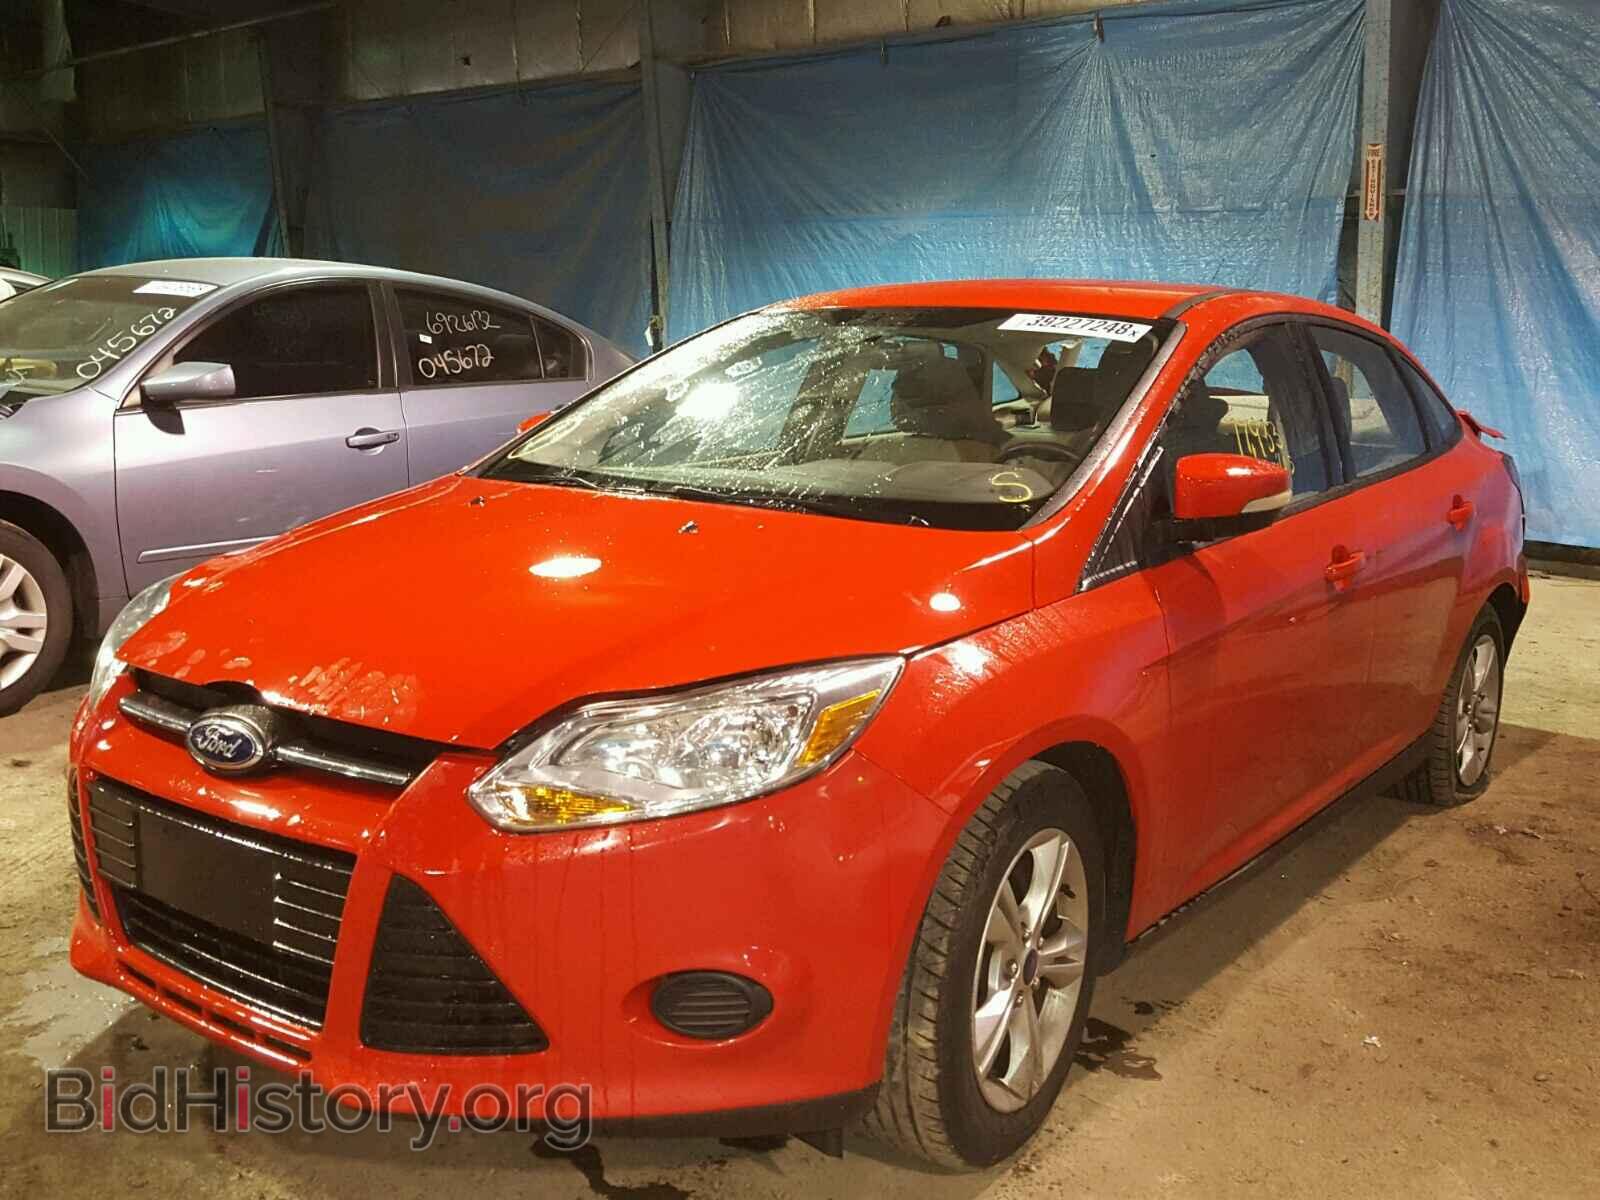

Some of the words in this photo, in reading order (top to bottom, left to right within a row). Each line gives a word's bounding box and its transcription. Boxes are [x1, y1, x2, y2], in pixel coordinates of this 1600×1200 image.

[76, 306, 177, 380] 045672
[418, 343, 495, 379] 045672
[991, 471, 1033, 503] S
[195, 724, 243, 759] Ford
